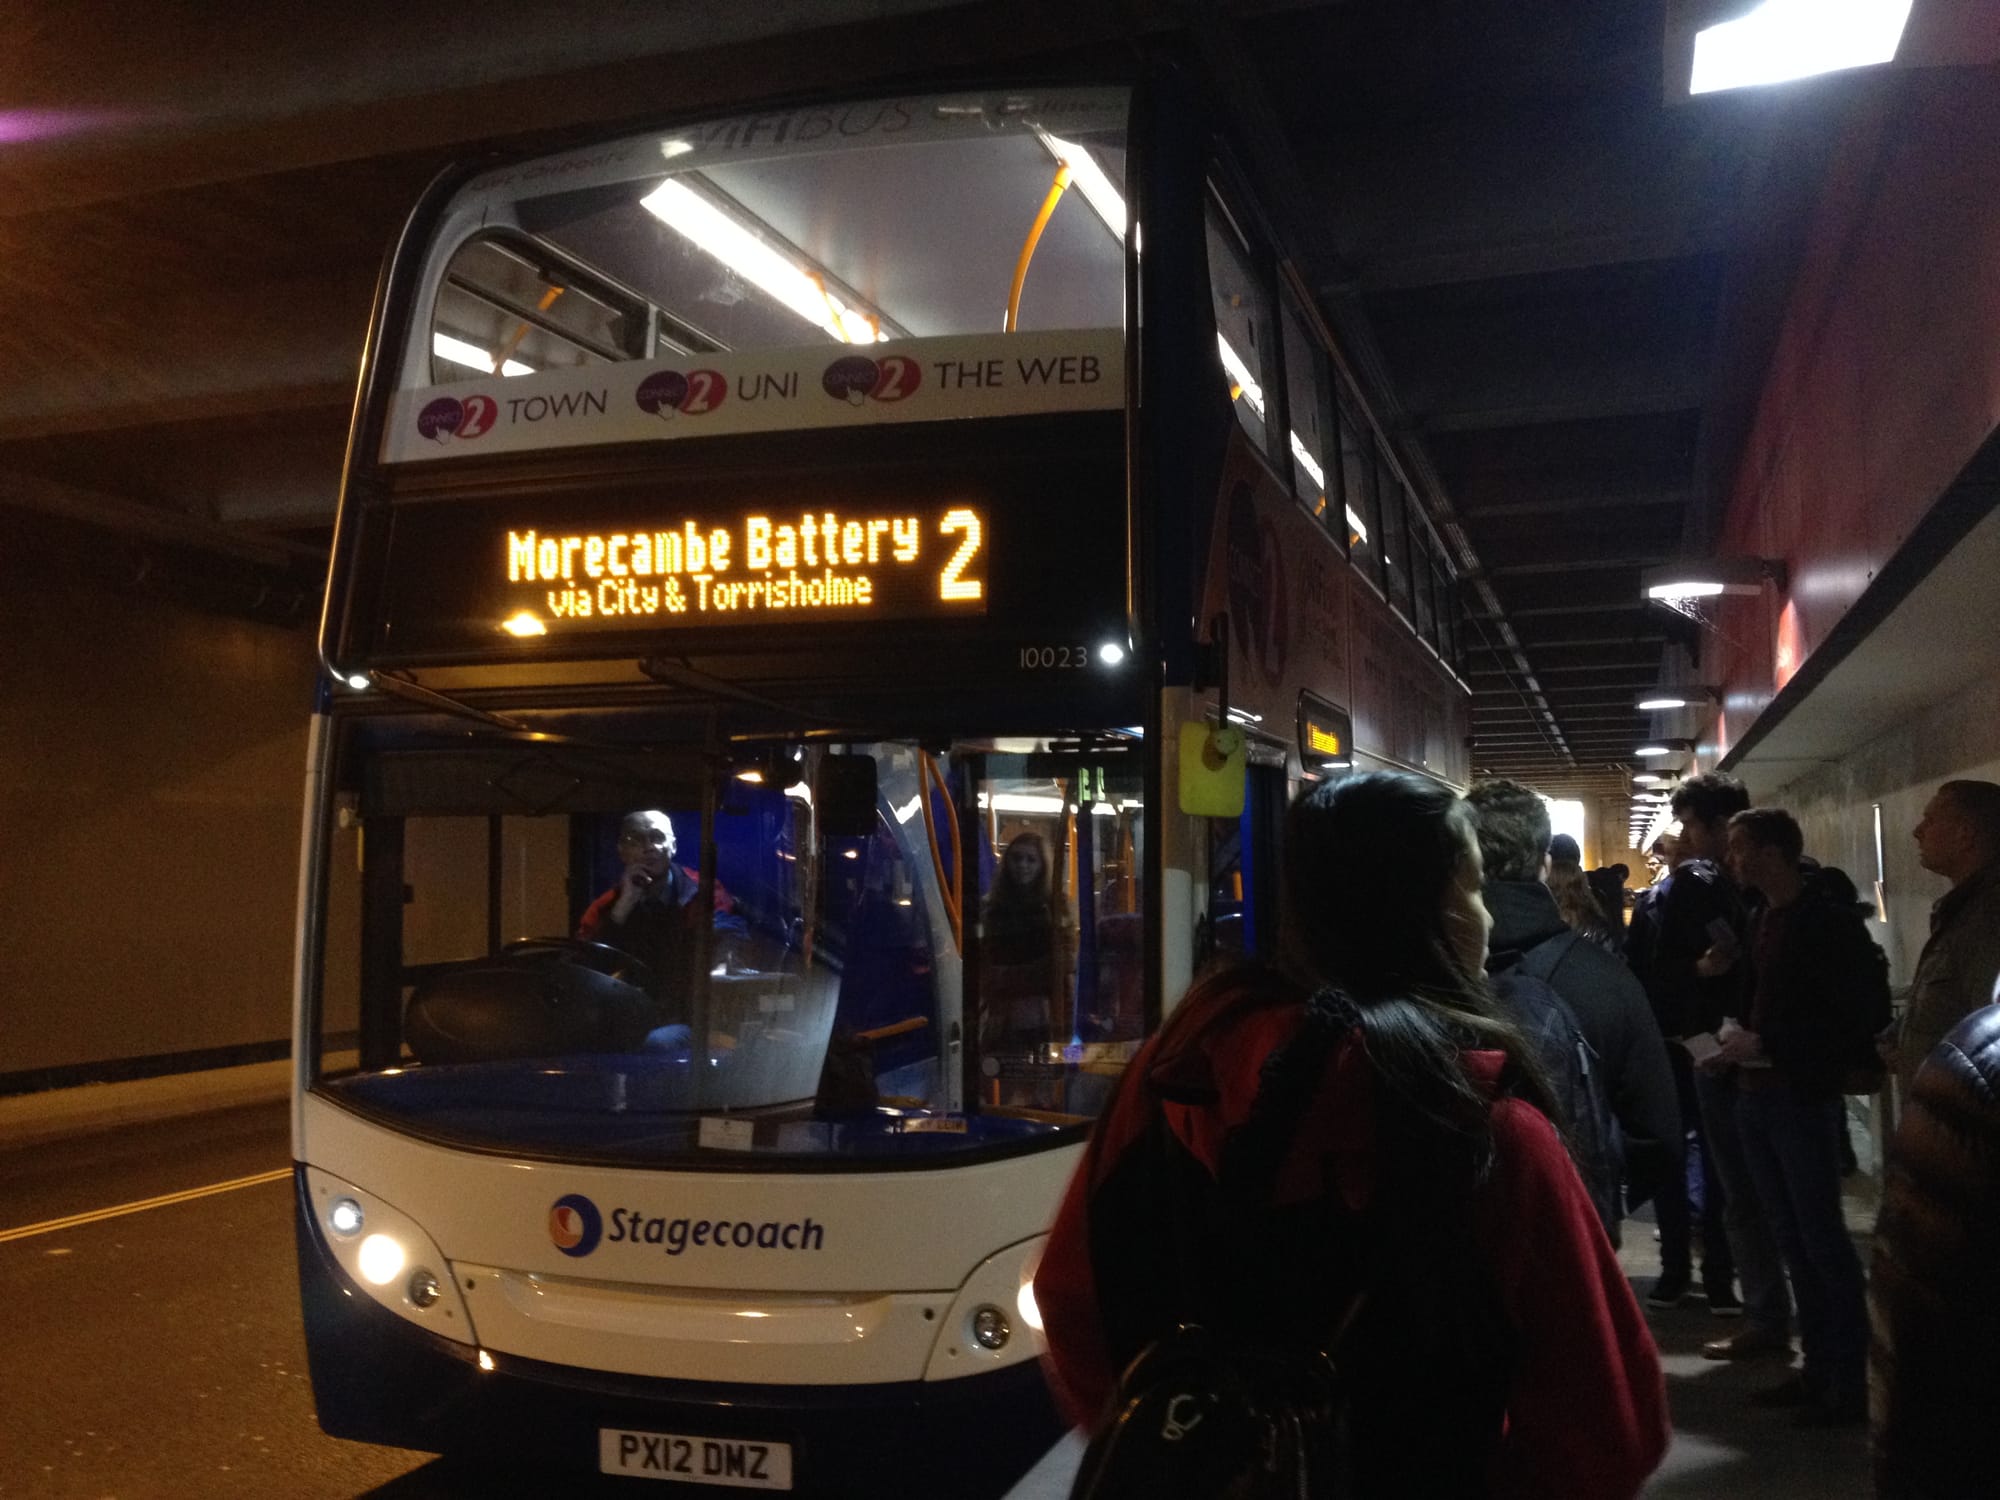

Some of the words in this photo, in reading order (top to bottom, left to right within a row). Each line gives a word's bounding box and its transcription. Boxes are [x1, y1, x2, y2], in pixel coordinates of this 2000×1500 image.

[507, 390, 608, 424] TOWN
[736, 371, 798, 401] UNI
[877, 359, 904, 398] 2
[933, 360, 1004, 389] THE
[1016, 355, 1101, 386] WEB
[508, 519, 731, 582] Morecambe
[746, 513, 920, 570] Battery
[940, 509, 983, 600] 2
[547, 589, 592, 618] via
[598, 579, 660, 616] City
[664, 577, 687, 613] &
[692, 569, 873, 612] Torrisholme
[1020, 646, 1088, 669] 10023
[608, 1207, 825, 1256] Stagecoach
[620, 1434, 692, 1474] PX12
[703, 1442, 769, 1480] DMZ
